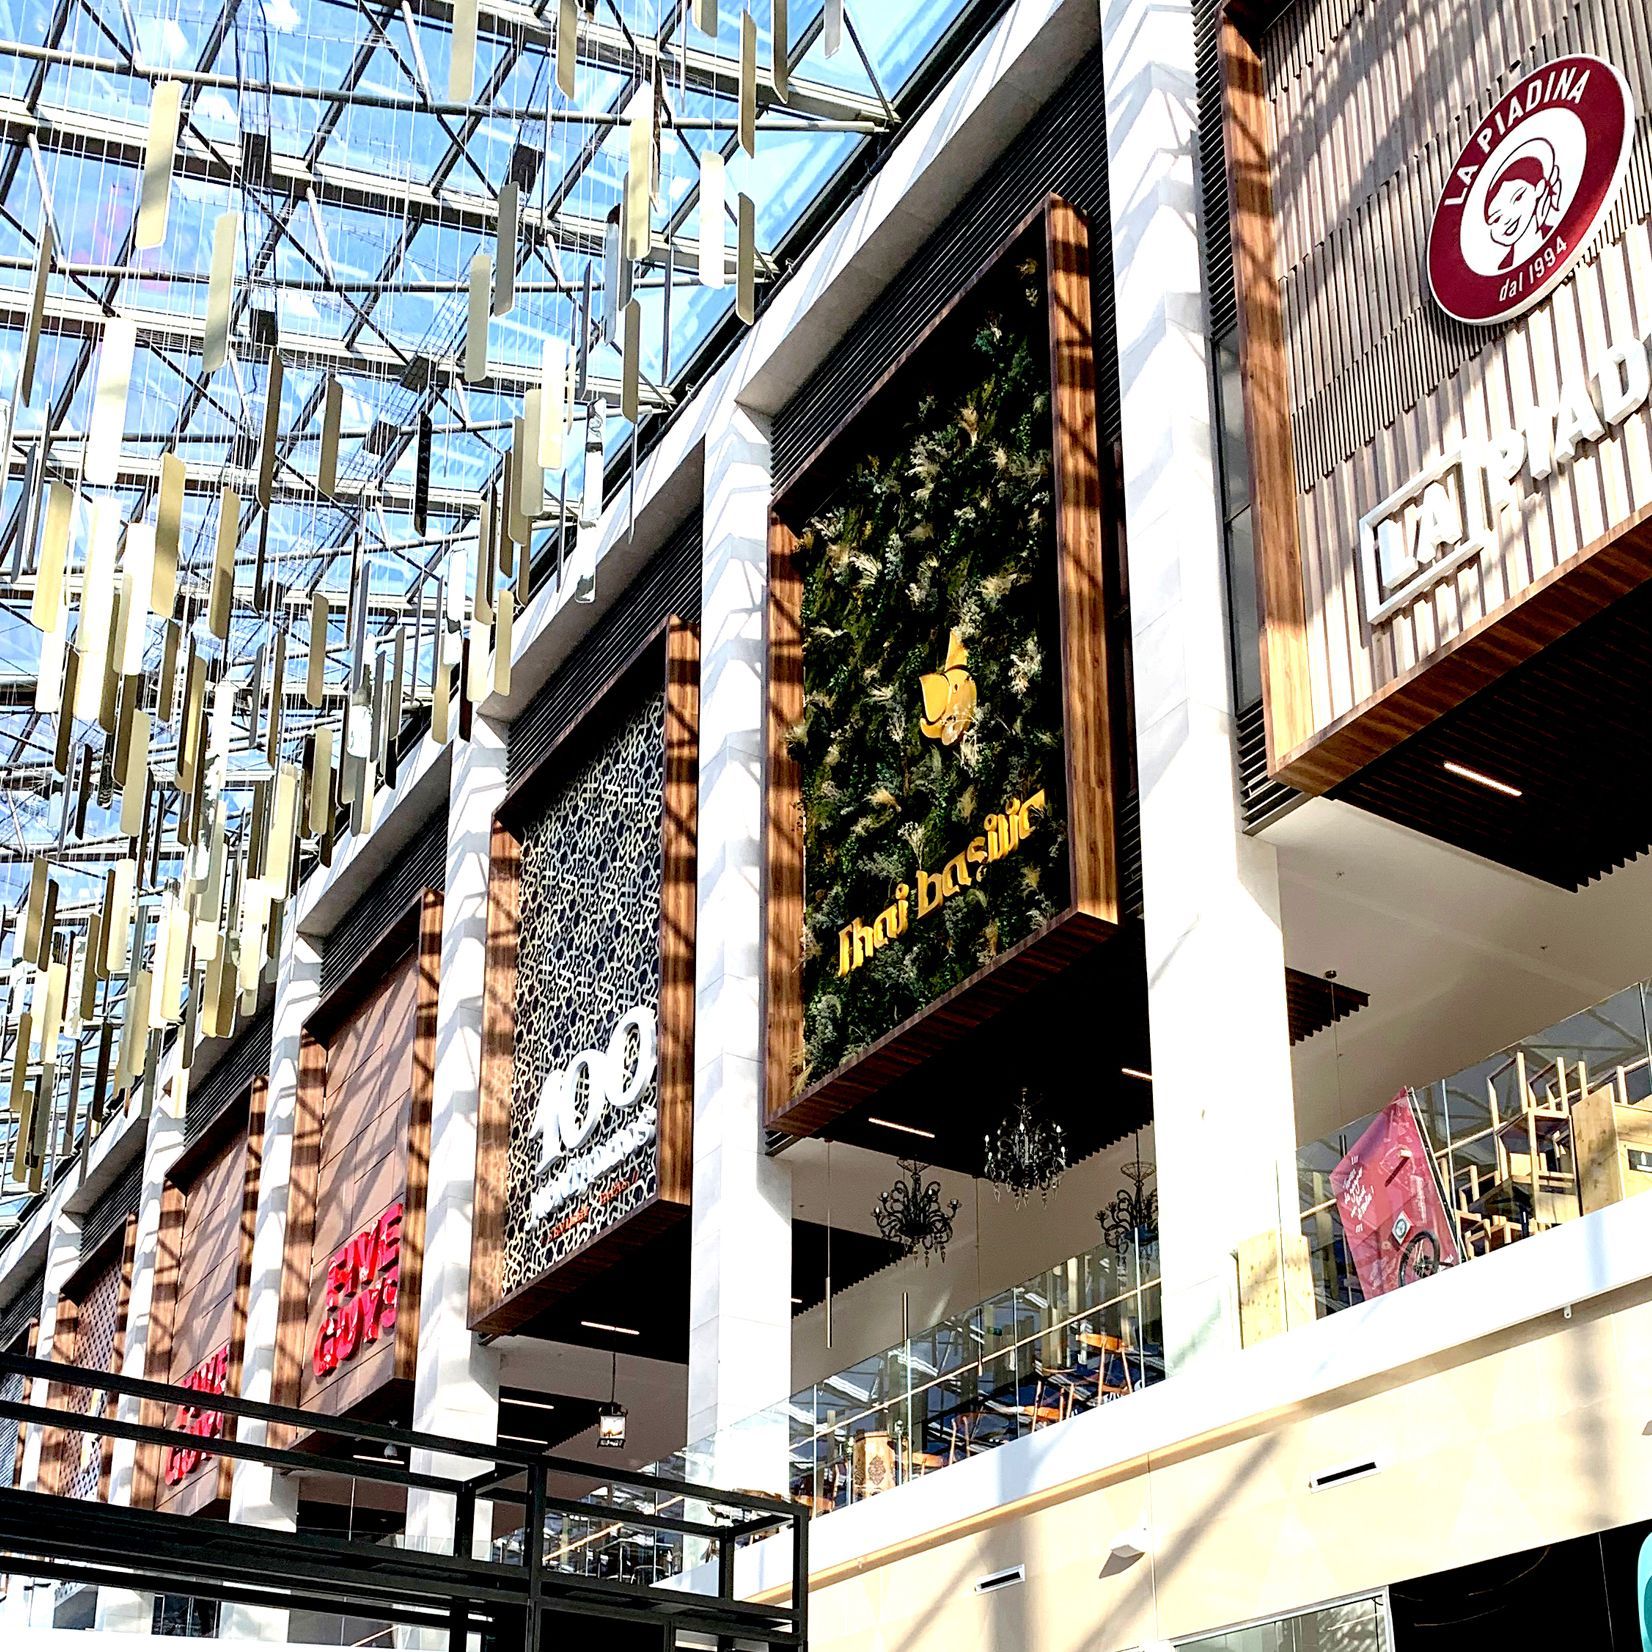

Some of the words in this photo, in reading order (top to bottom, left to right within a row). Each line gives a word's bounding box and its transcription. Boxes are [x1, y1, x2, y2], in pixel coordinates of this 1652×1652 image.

[1444, 163, 1479, 206] LA
[1477, 67, 1591, 154] PIADINA
[1499, 278, 1524, 302] dal
[1529, 237, 1567, 282] 1994
[1377, 479, 1463, 590] LA
[1484, 336, 1652, 520] PIAD
[529, 1005, 658, 1176] 100
[326, 1203, 404, 1312] FIVE
[312, 1266, 398, 1376] GUYS
